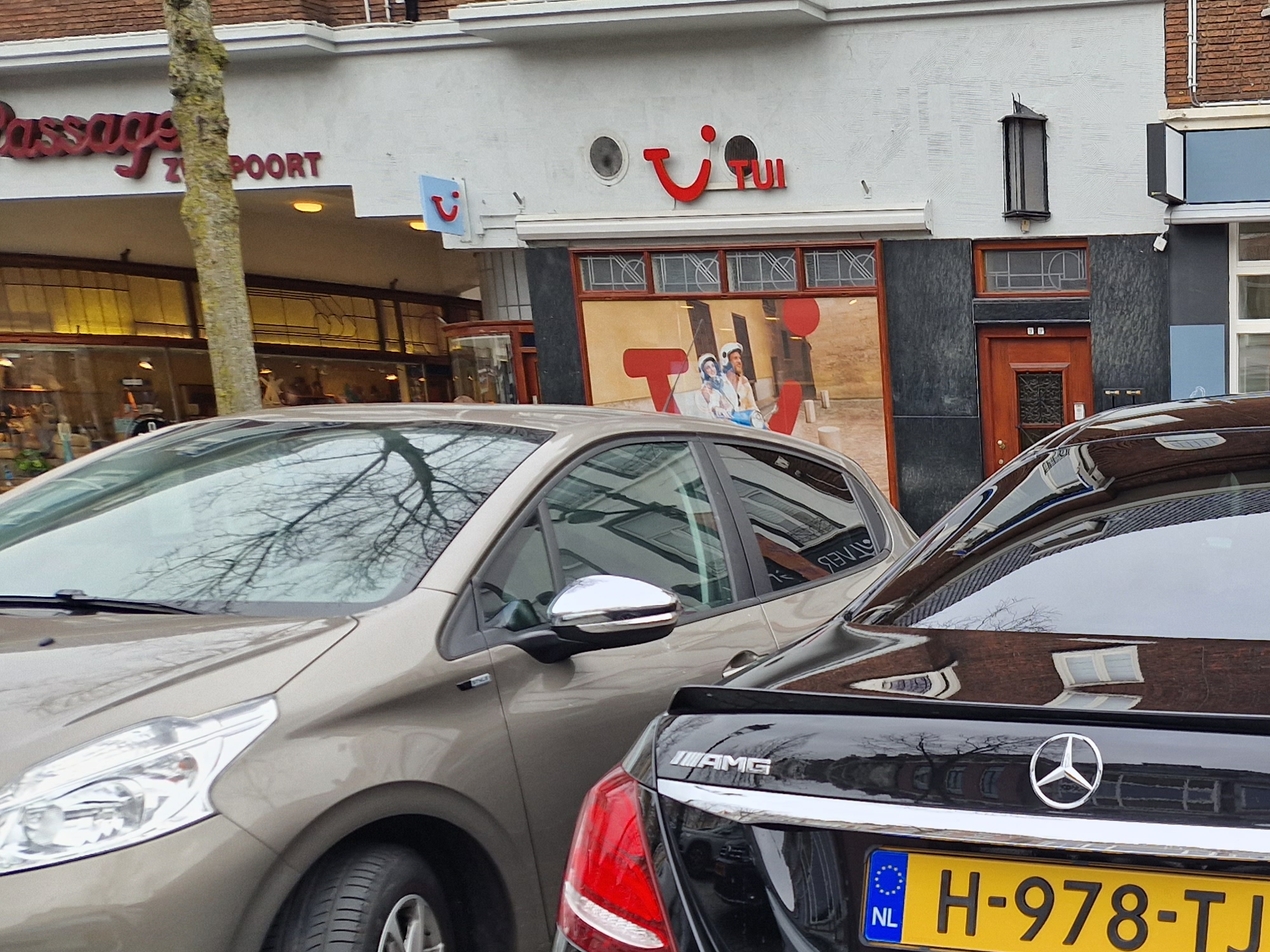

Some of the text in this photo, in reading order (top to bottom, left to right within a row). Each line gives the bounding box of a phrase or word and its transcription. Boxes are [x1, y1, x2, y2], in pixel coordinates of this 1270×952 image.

[728, 158, 787, 191] TUI
[696, 753, 772, 776] AMG
[871, 906, 899, 928] NL
